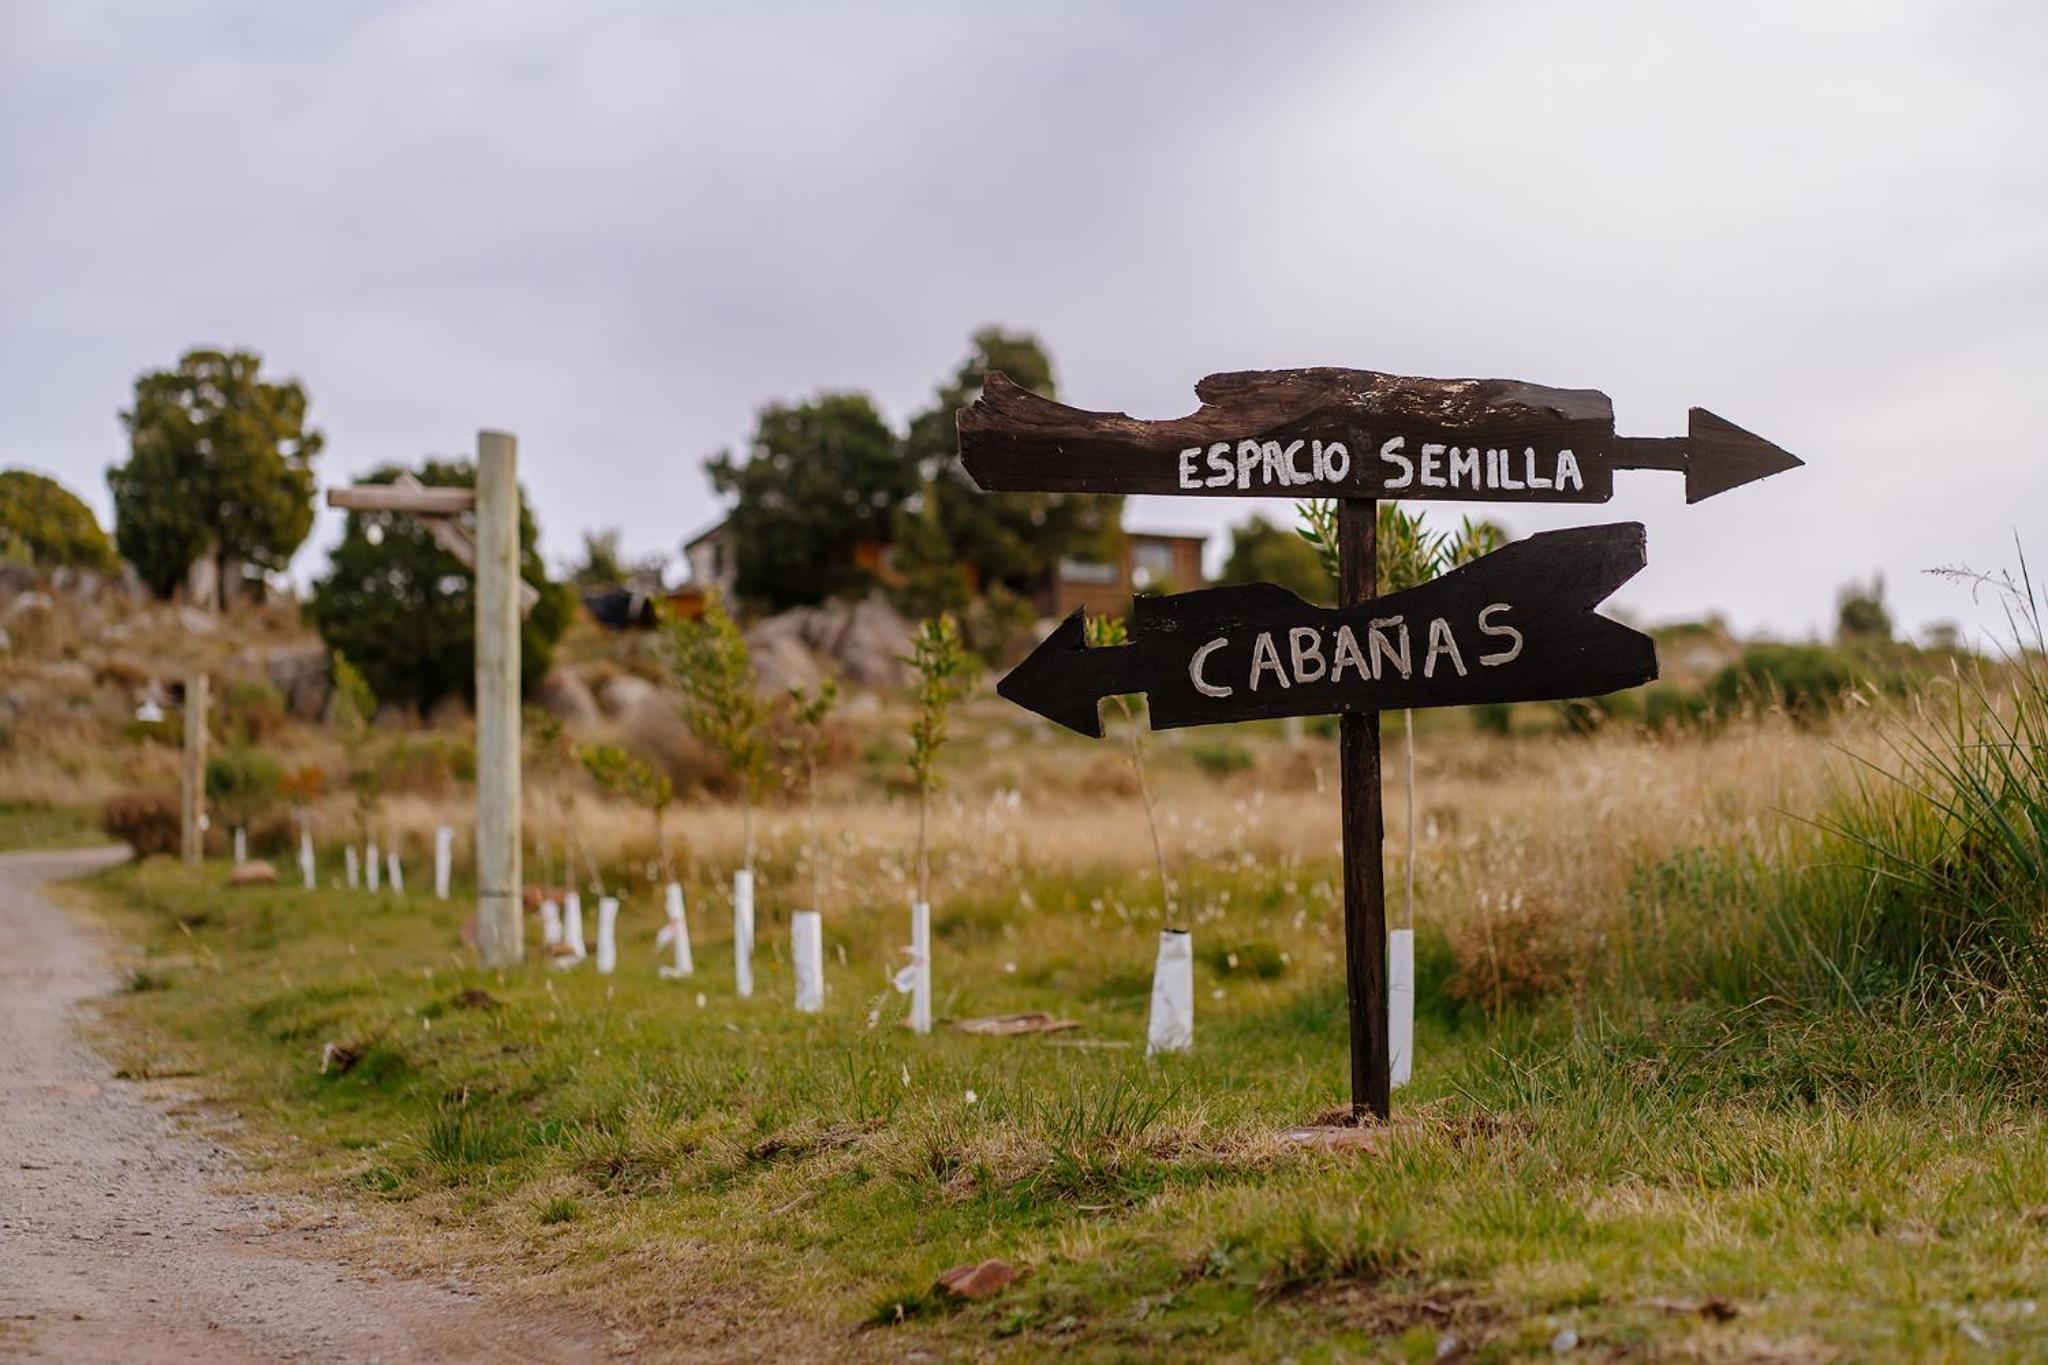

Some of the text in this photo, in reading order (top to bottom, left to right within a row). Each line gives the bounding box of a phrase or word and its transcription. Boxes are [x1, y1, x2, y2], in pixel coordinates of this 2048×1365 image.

[1178, 435, 1585, 493] ESPACIO SEMILLA
[1188, 602, 1525, 699] CABAÑAS
